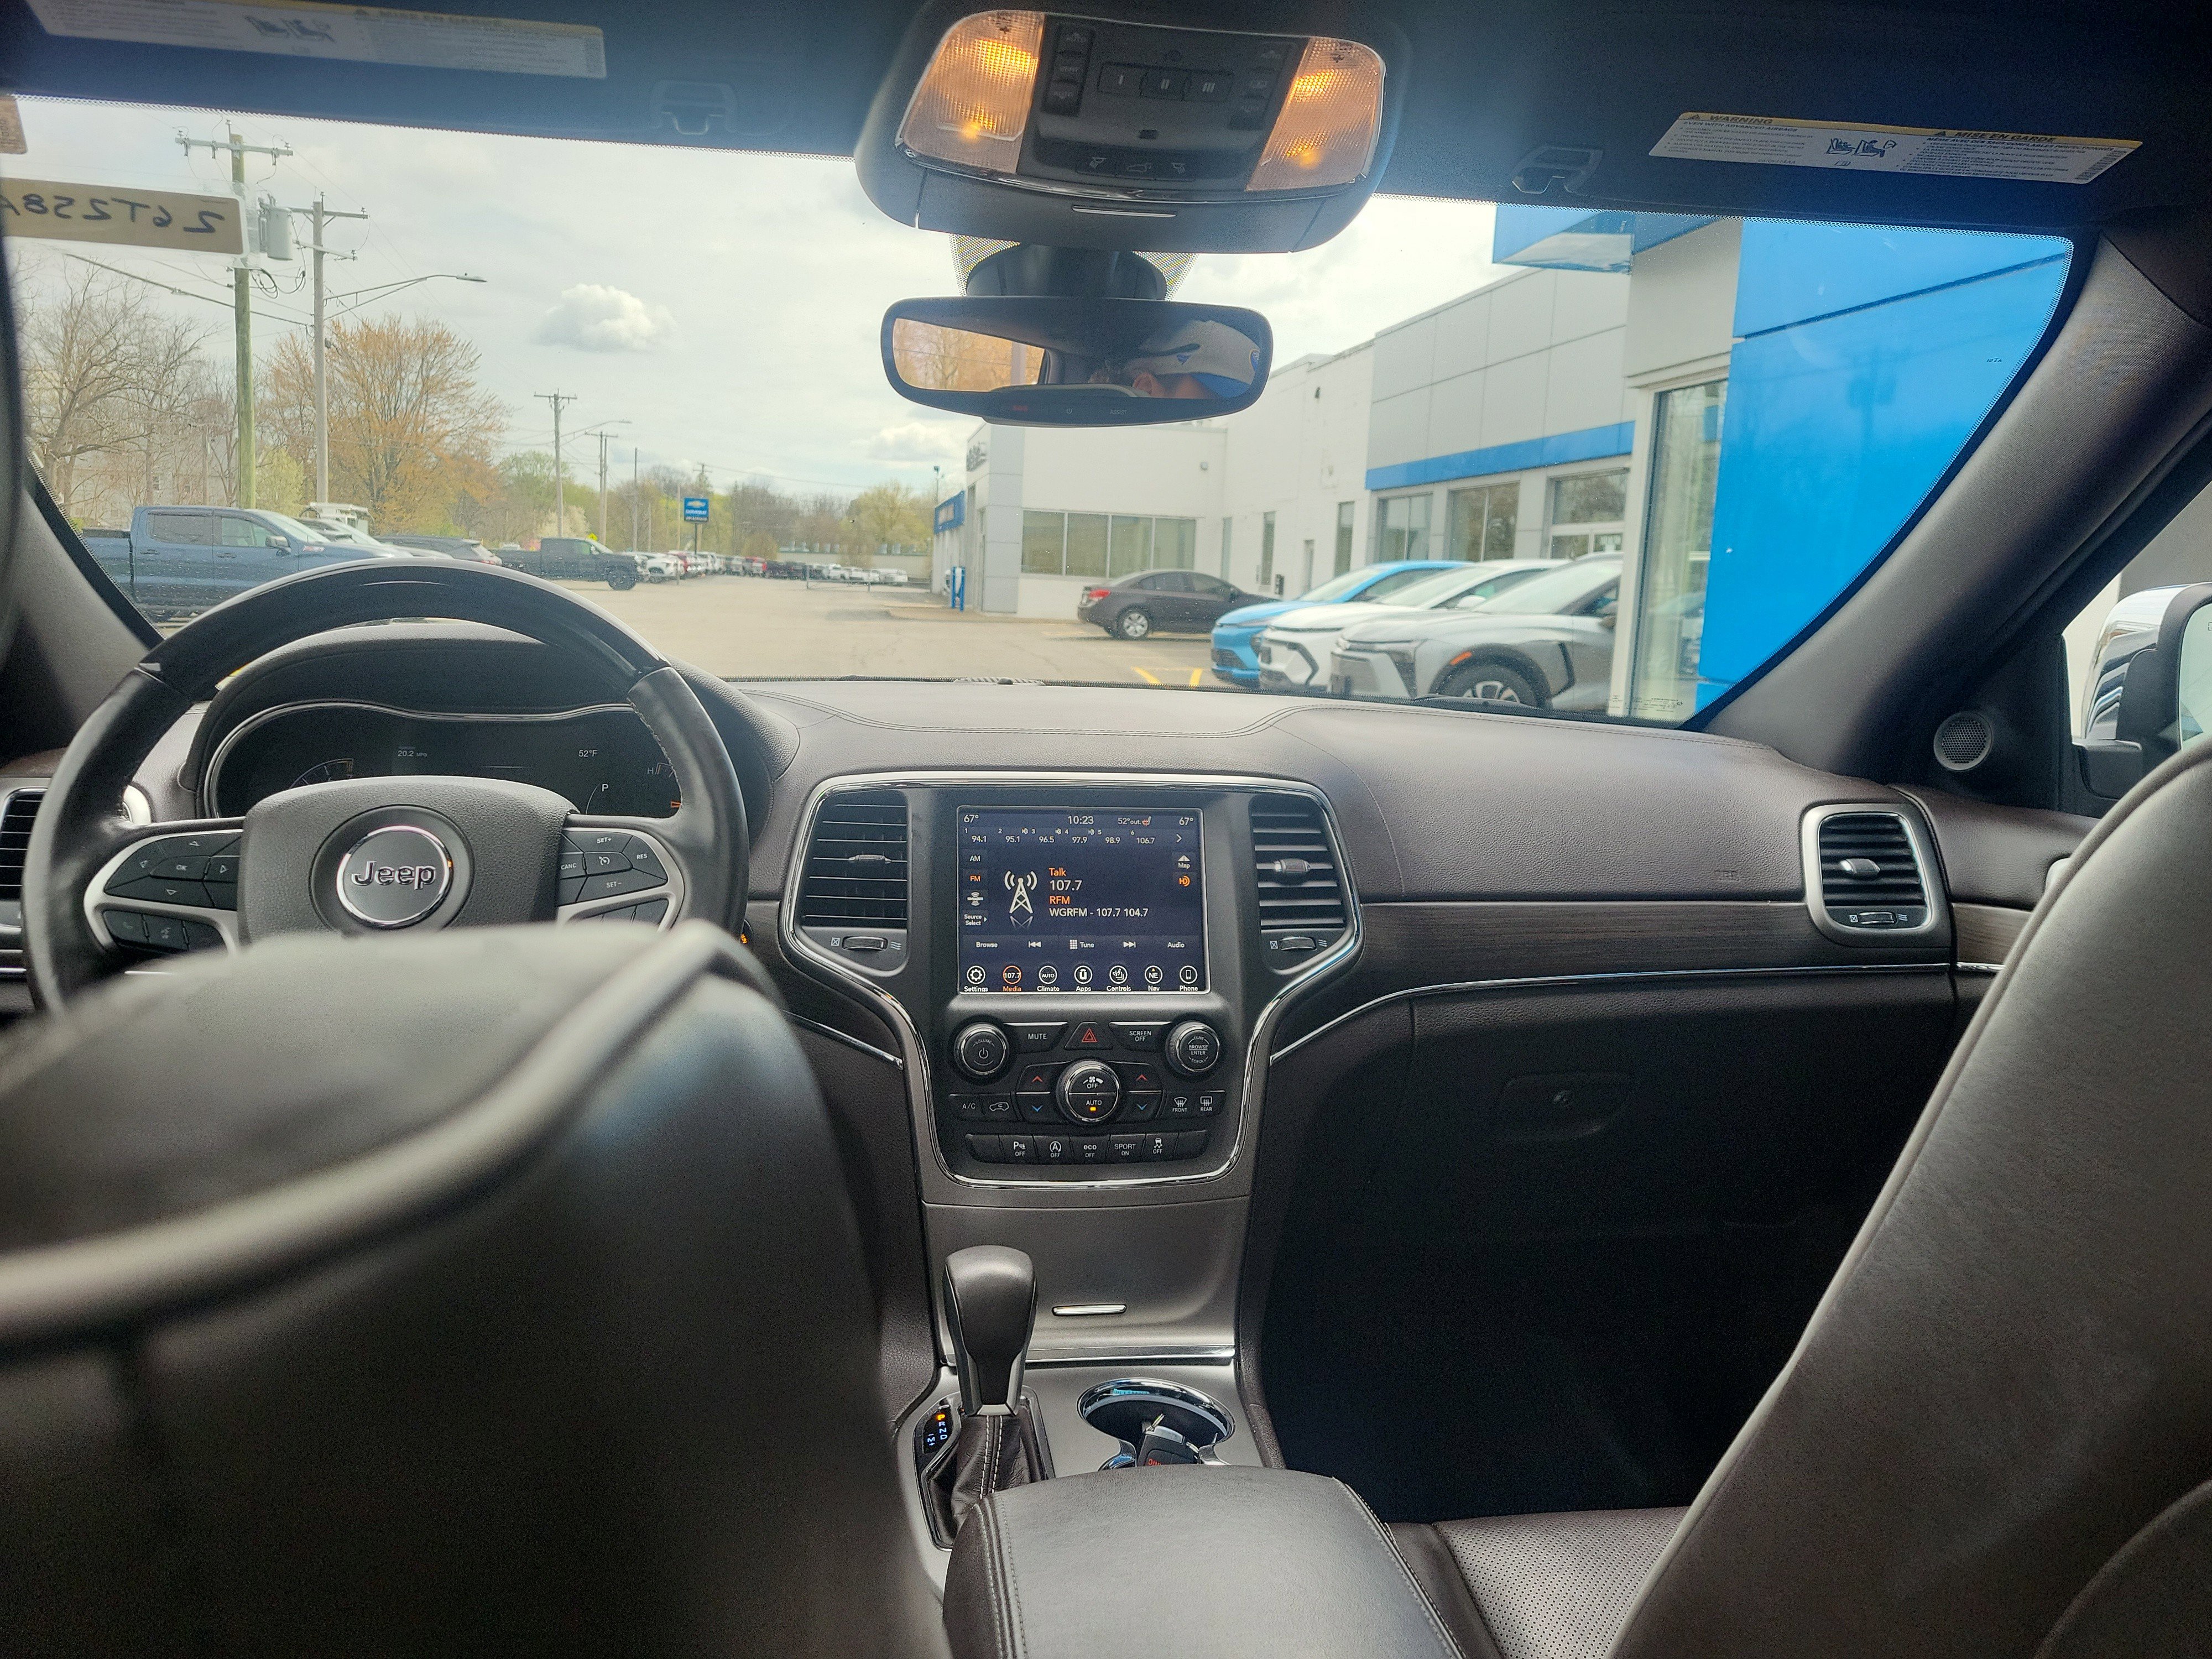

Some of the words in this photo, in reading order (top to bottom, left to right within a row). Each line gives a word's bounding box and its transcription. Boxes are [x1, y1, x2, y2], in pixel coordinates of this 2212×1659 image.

[1710, 114, 1773, 124] WARNING
[963, 815, 979, 823] 67°
[1068, 816, 1094, 825] 10:23
[1179, 817, 1194, 826] 67°
[351, 860, 436, 890] Jeep
[1049, 868, 1067, 877] Talk
[1050, 880, 1082, 891] 107.7
[1050, 896, 1071, 905] RFM
[1049, 908, 1088, 917] WGRFM
[1097, 908, 1121, 917] 107.7
[1124, 908, 1149, 917] 104.7
